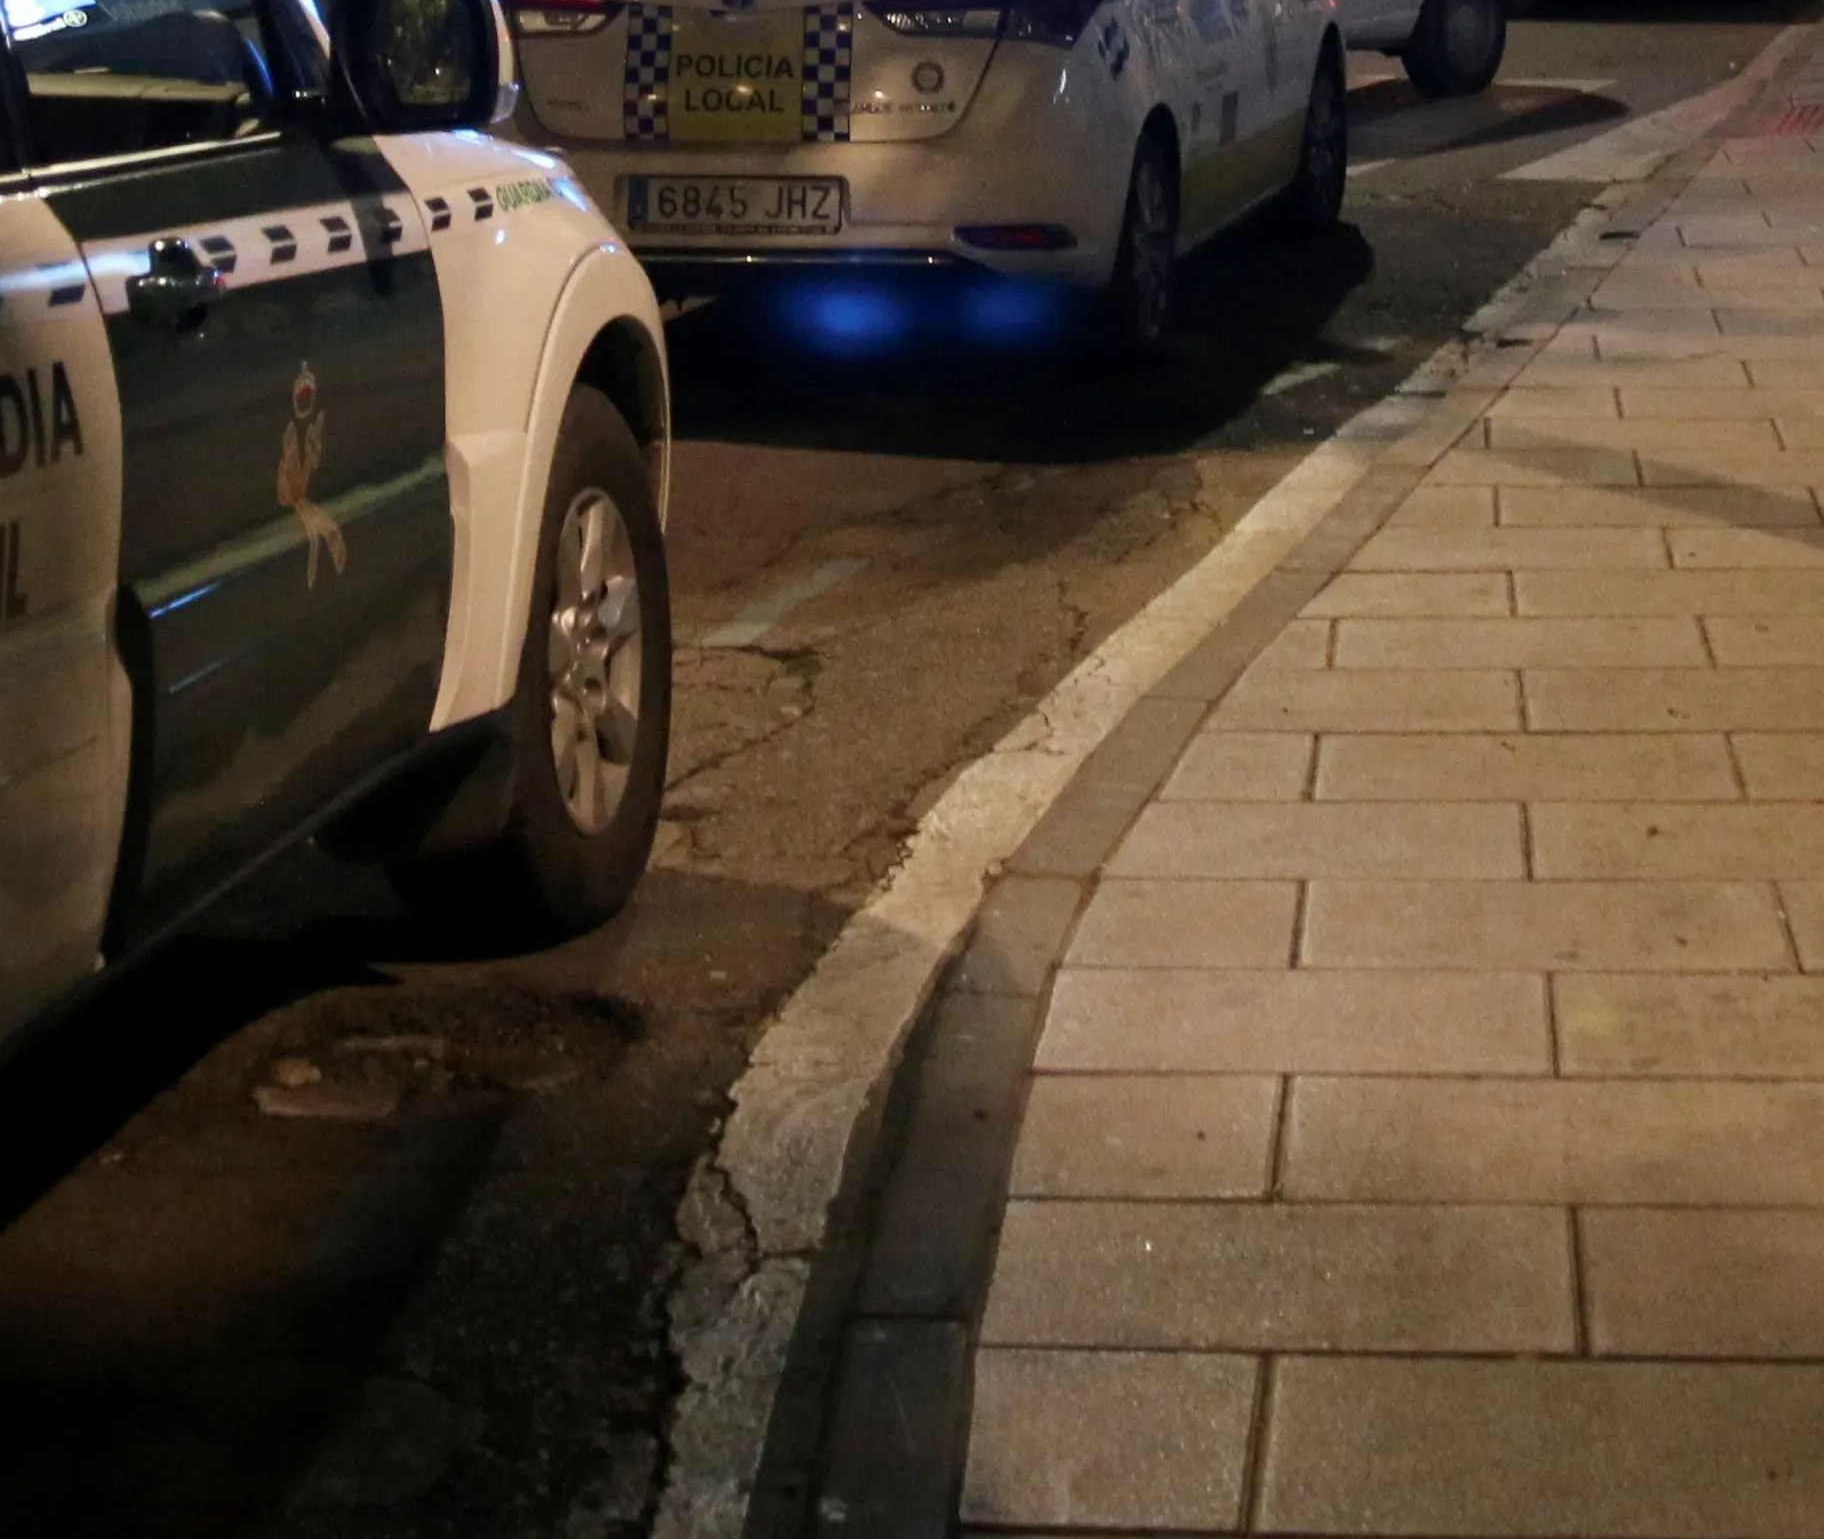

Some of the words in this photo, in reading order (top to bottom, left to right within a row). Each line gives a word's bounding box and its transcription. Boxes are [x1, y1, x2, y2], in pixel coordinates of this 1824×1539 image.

[677, 54, 795, 80] POLICIA
[685, 88, 784, 113] LOCAL
[657, 184, 749, 220] 6845
[765, 184, 832, 220] JHZ
